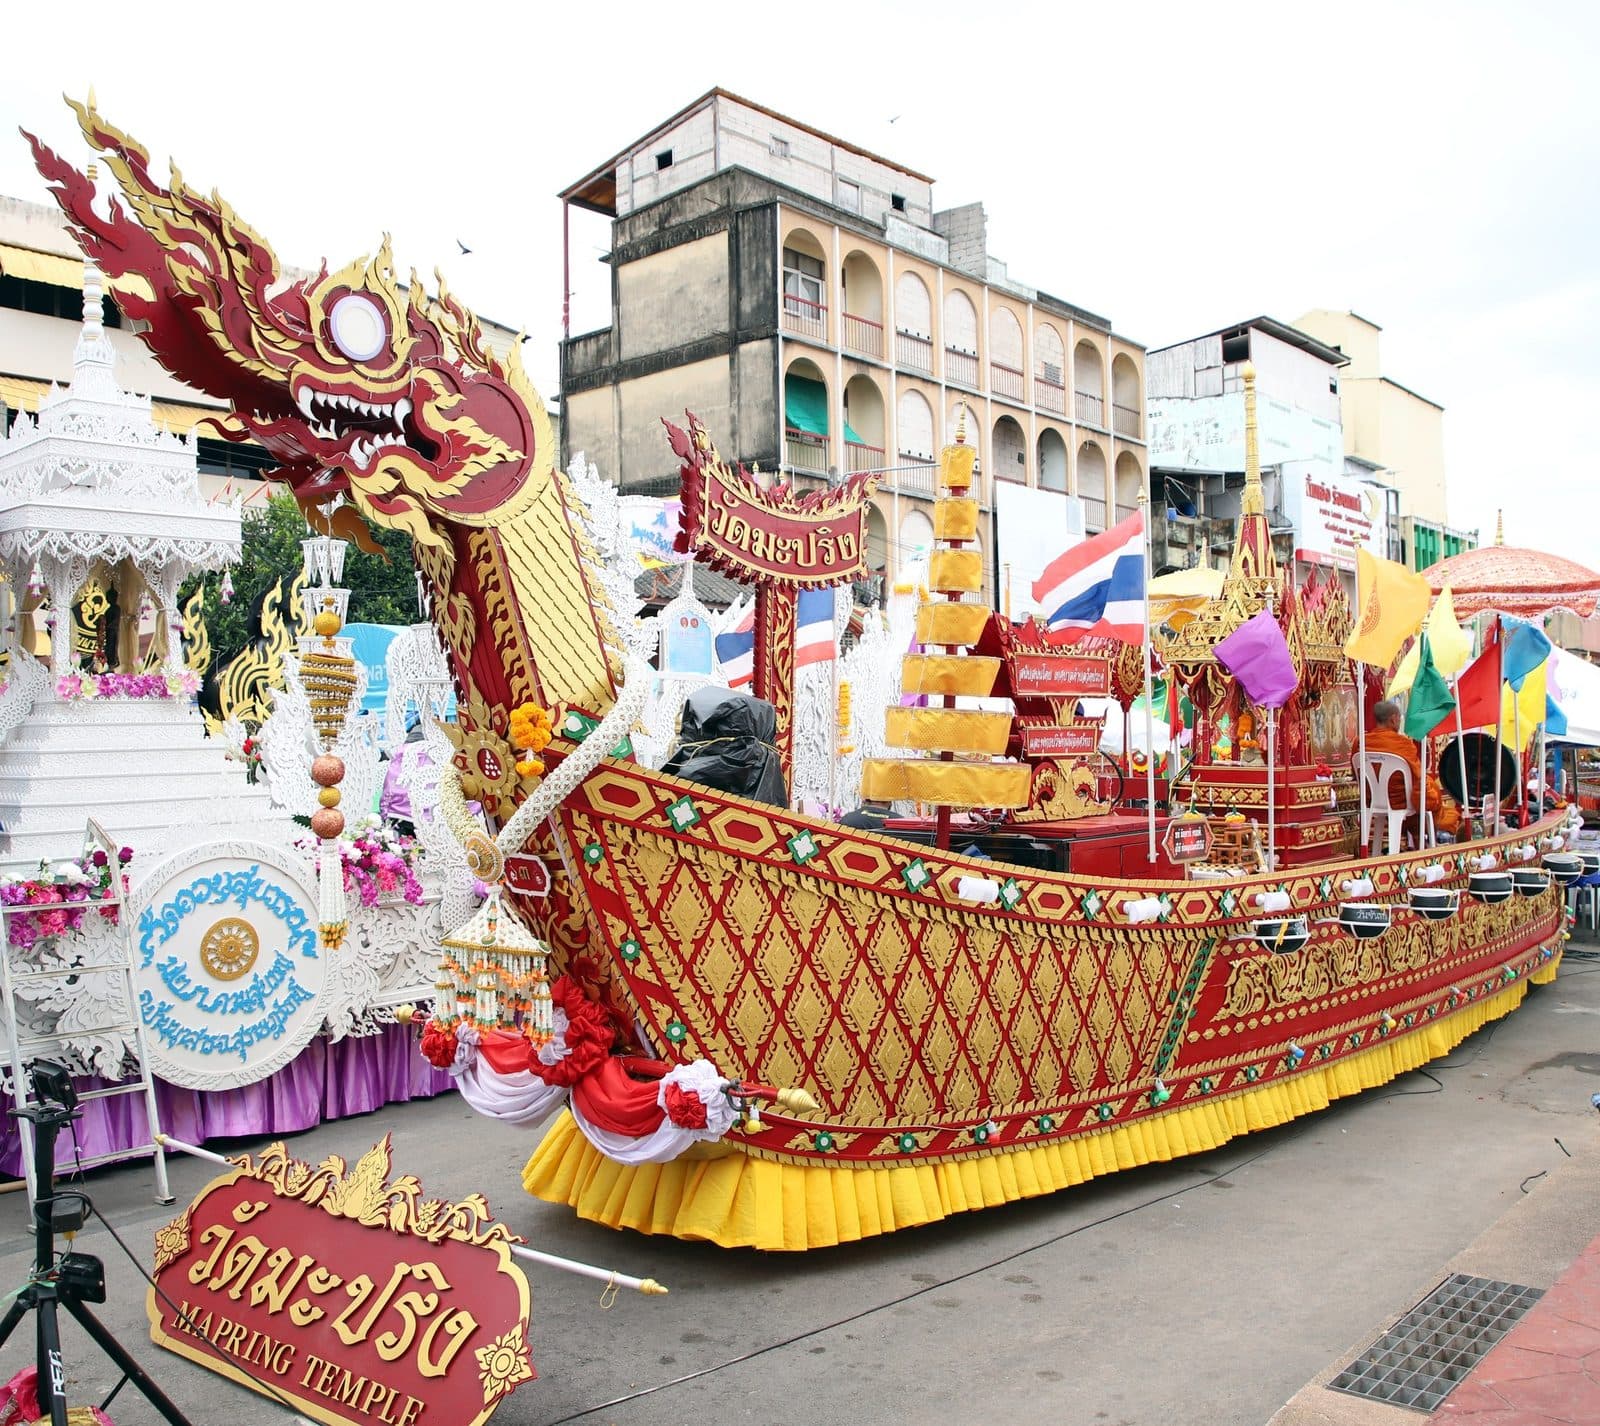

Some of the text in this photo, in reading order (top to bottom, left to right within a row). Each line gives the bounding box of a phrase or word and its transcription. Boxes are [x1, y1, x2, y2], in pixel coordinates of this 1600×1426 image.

[711, 490, 858, 567] วัดมะปริง
[188, 1200, 480, 1378] วัดมะปริง
[171, 1301, 425, 1426] MAPRING TEMPLE
